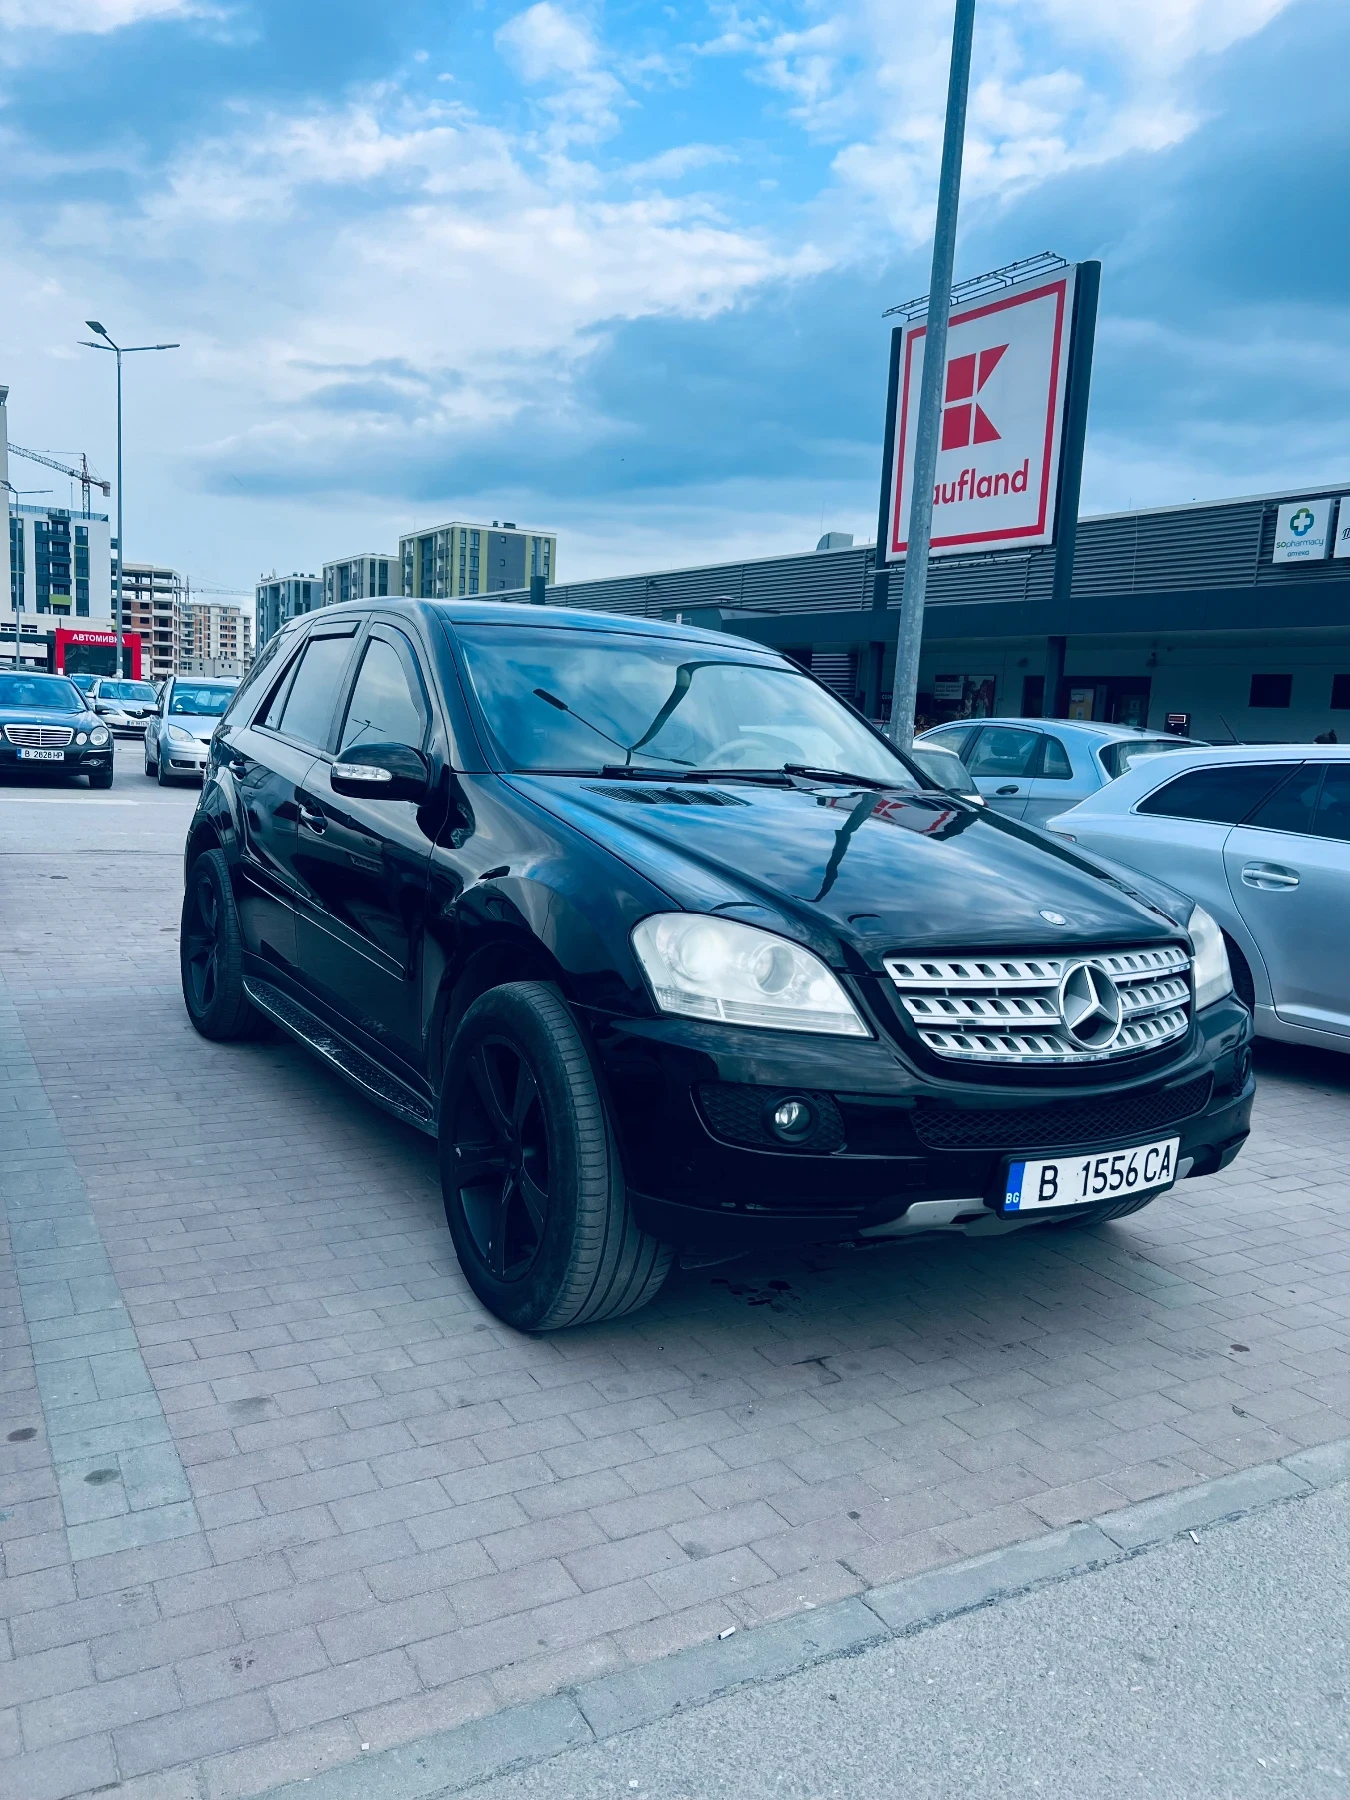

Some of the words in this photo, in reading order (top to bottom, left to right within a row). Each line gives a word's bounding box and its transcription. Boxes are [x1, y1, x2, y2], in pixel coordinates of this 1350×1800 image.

[933, 458, 1029, 505] aufland
[1276, 538, 1324, 549] sopharmacy
[1038, 1164, 1059, 1202] B
[1005, 1192, 1020, 1204] BG
